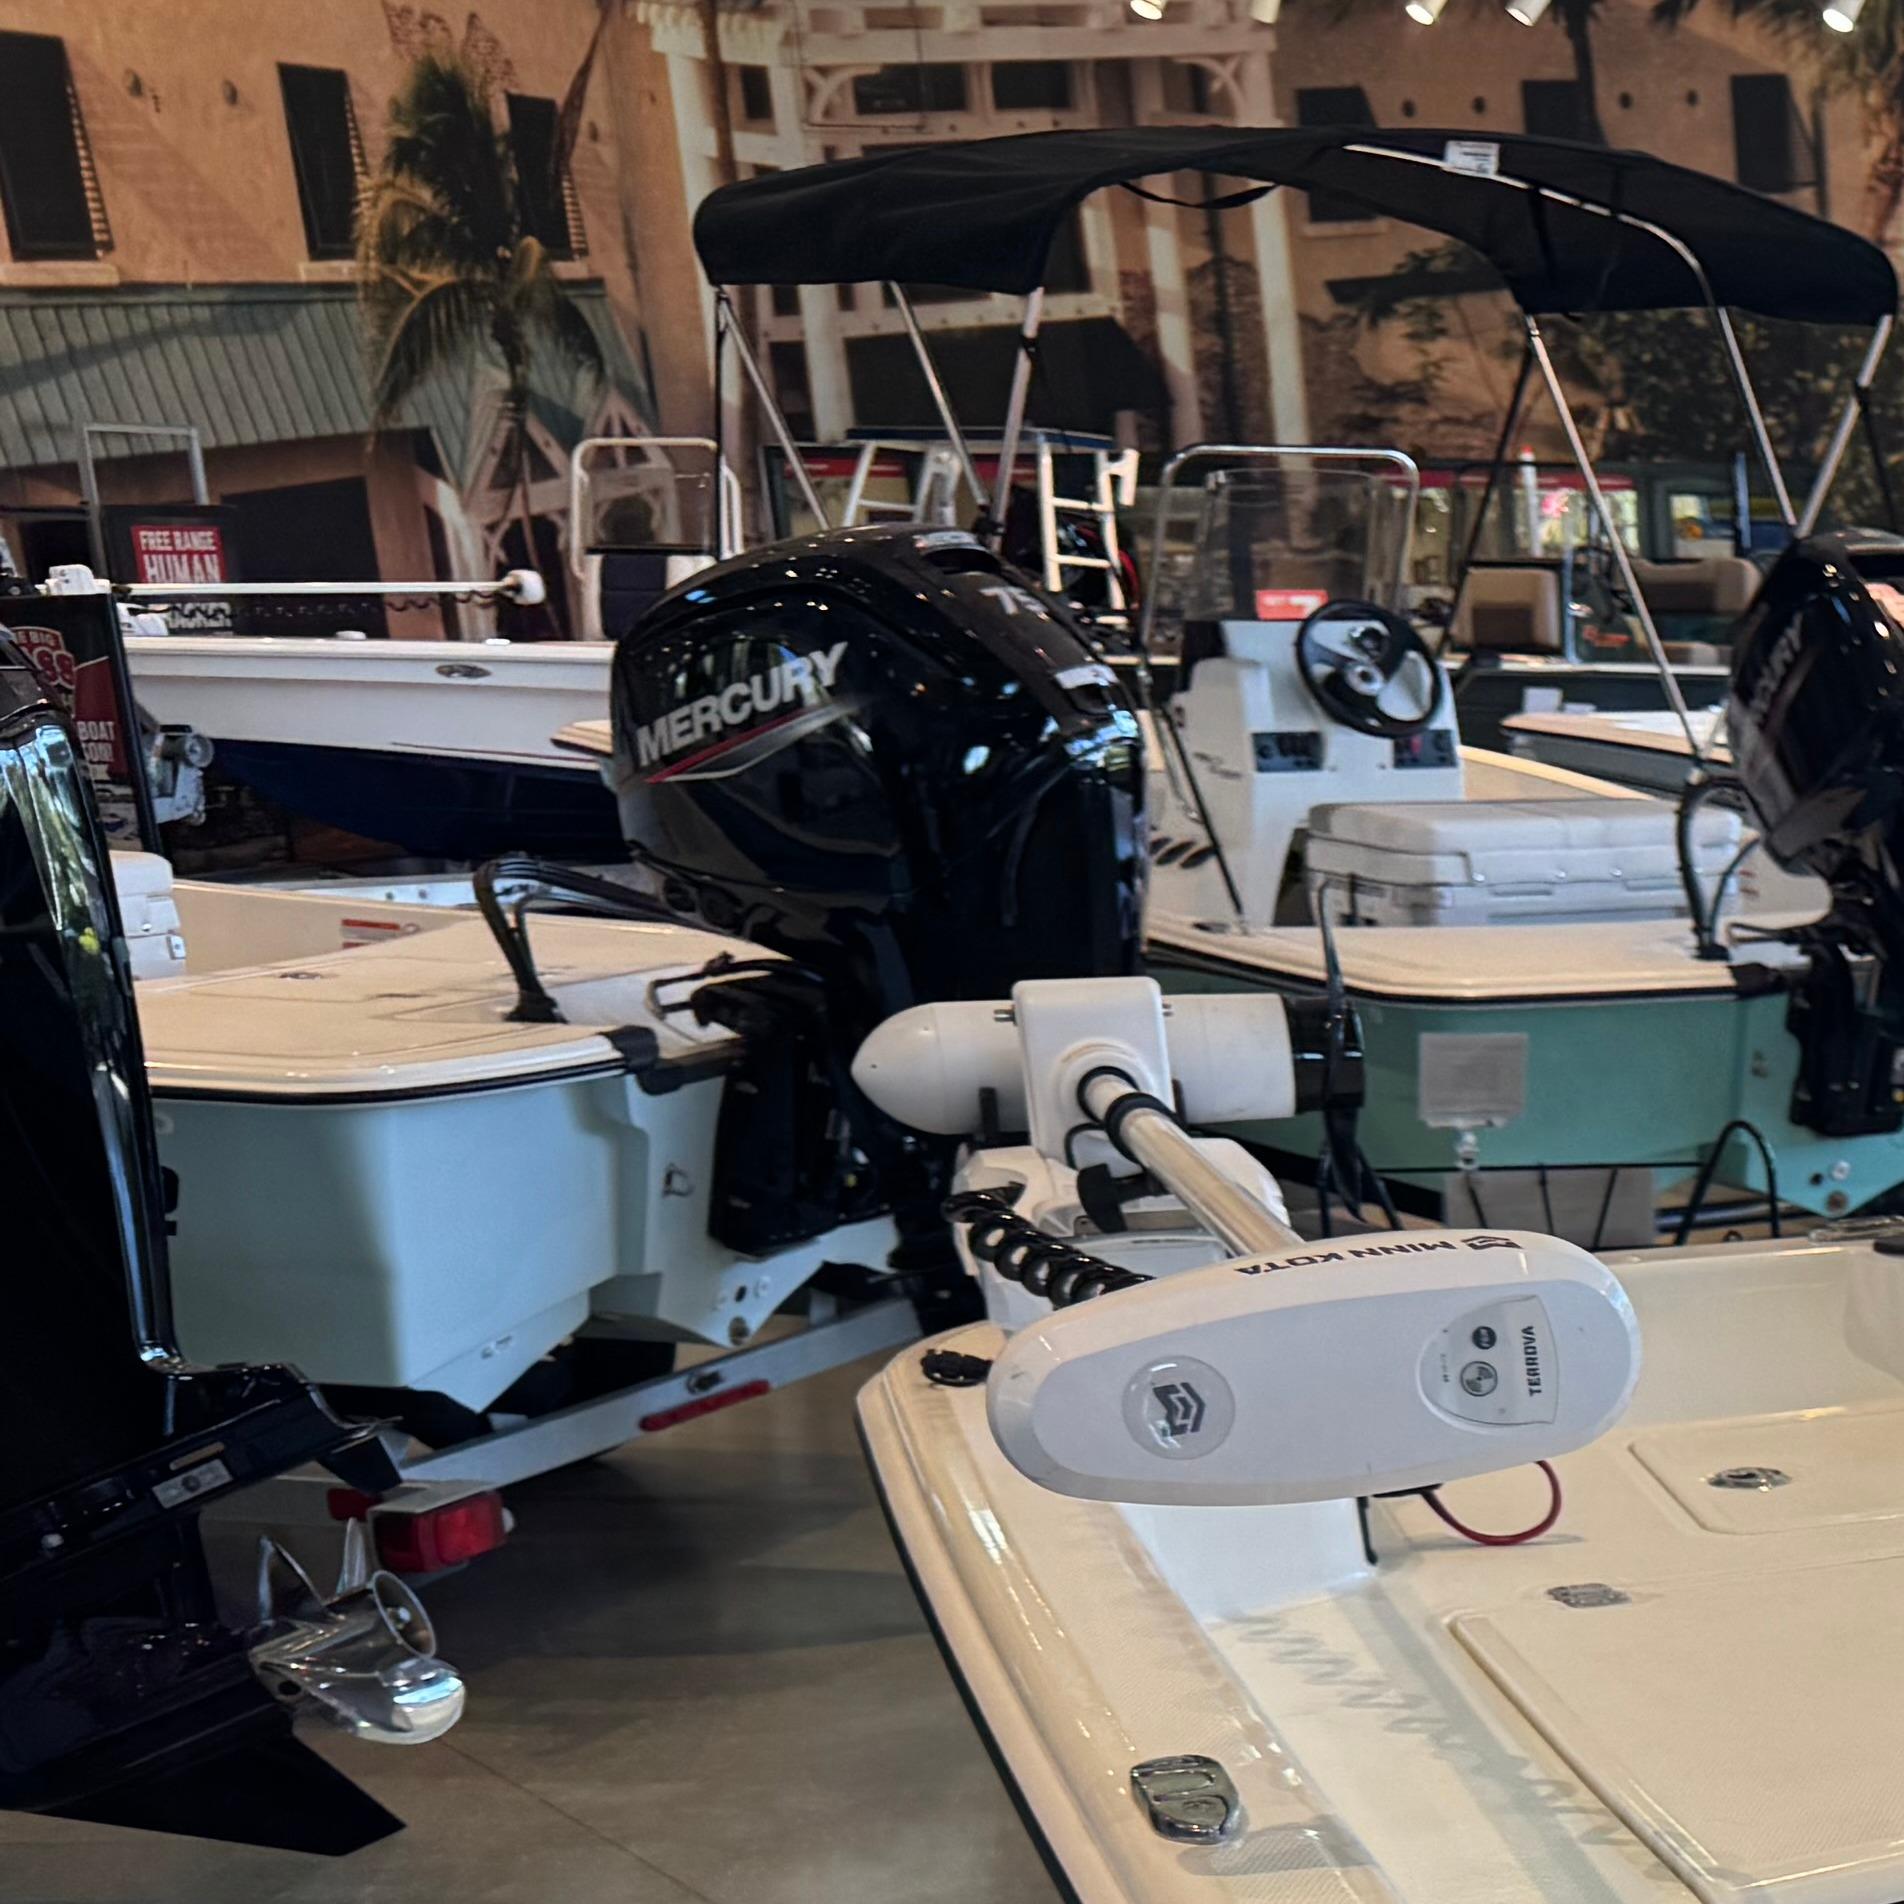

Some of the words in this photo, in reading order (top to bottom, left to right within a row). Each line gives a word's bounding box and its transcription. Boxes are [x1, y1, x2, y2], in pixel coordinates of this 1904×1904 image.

[140, 531, 172, 551] FREE
[173, 531, 217, 551] RANGE
[143, 554, 221, 583] HUMAN
[635, 641, 849, 767] MERCURY
[1347, 1240, 1457, 1258] MINN
[1235, 1252, 1344, 1276] KOTA
[1521, 1325, 1542, 1397] TERROVA
